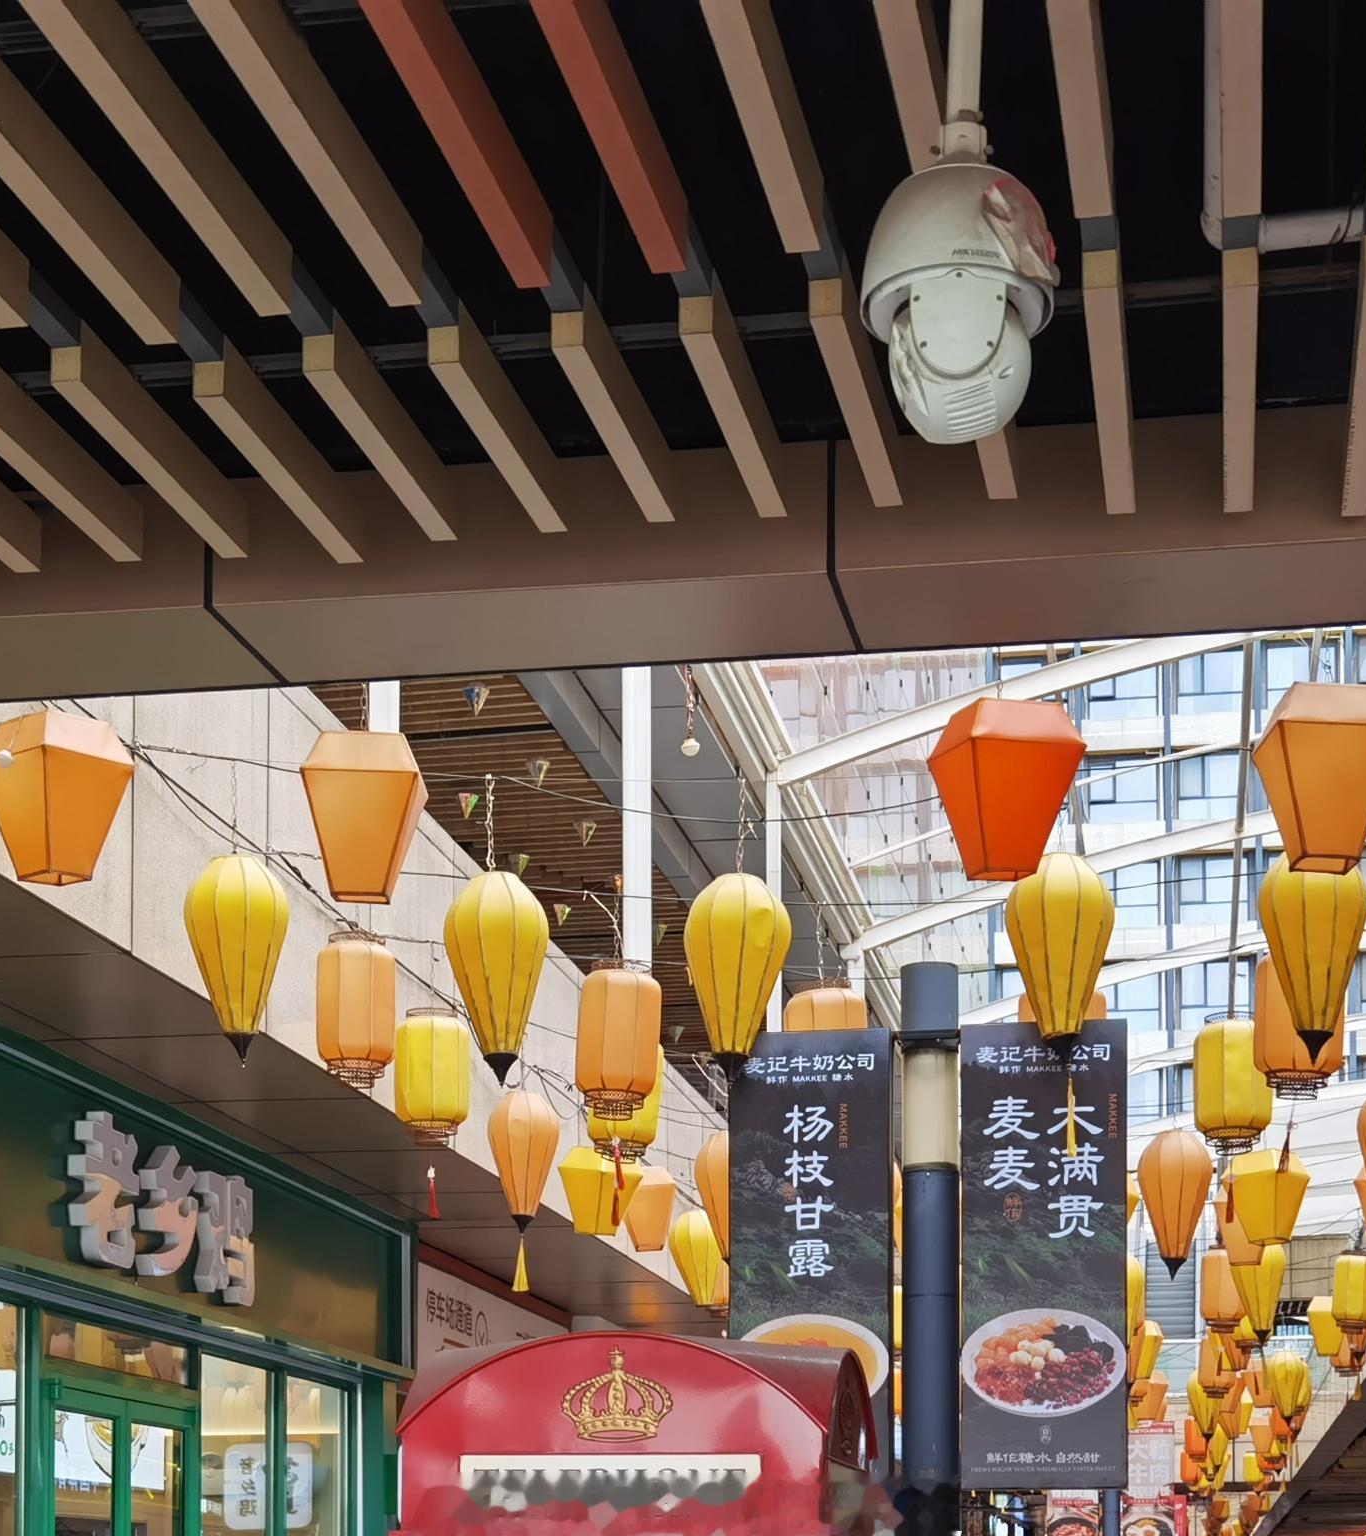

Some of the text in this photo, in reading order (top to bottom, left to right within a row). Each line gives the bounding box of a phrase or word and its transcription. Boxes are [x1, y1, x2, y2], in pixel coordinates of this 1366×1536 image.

[744, 1053, 875, 1075] 麦记牛奶公司
[792, 1074, 828, 1082] MAKKEE
[838, 1103, 848, 1150] MAKKEE
[1108, 1093, 1118, 1139] MAKKEE
[68, 1111, 256, 1307] 老乡鸡
[783, 1103, 835, 1279] 杨枝甘露
[426, 1288, 473, 1337] 停车场通道
[1056, 1451, 1101, 1464] 自然甜
